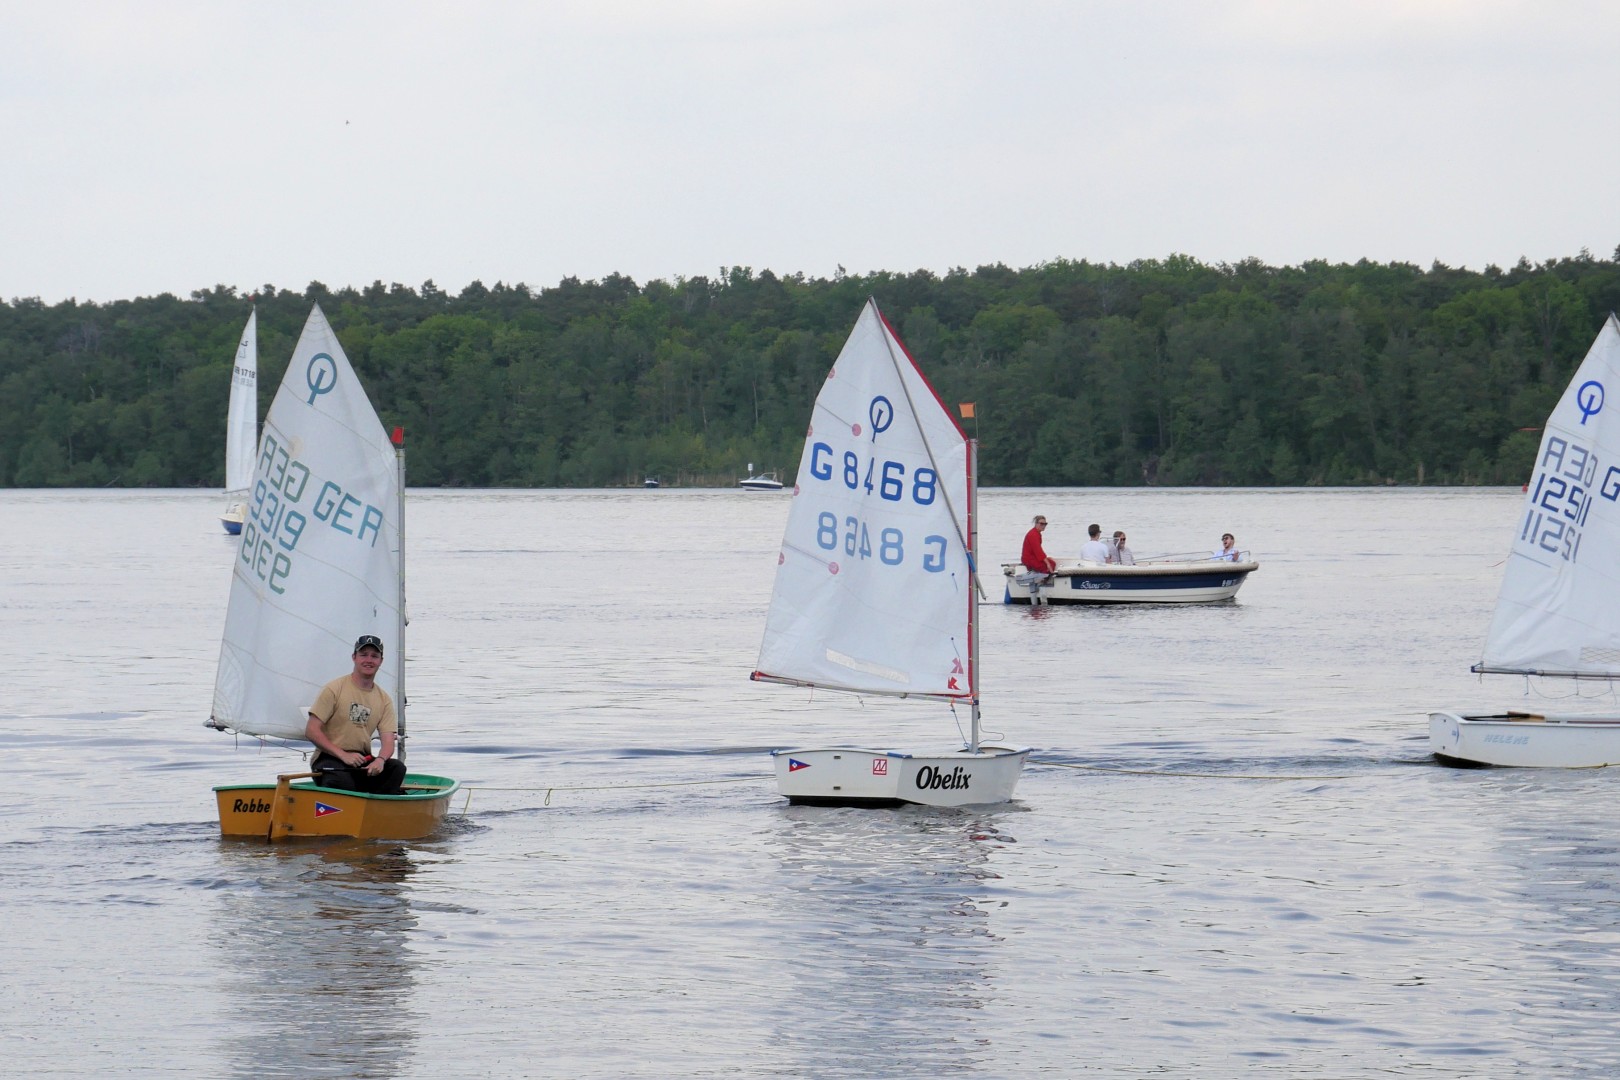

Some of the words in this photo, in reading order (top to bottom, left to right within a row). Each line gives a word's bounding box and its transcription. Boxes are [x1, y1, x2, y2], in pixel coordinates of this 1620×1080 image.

[810, 442, 833, 481] G
[843, 451, 937, 506] 8468
[1531, 472, 1593, 528] 12511
[251, 479, 306, 551] 9319
[313, 480, 383, 548] GER
[233, 798, 271, 813] Robbe
[915, 765, 972, 790] Obelix
